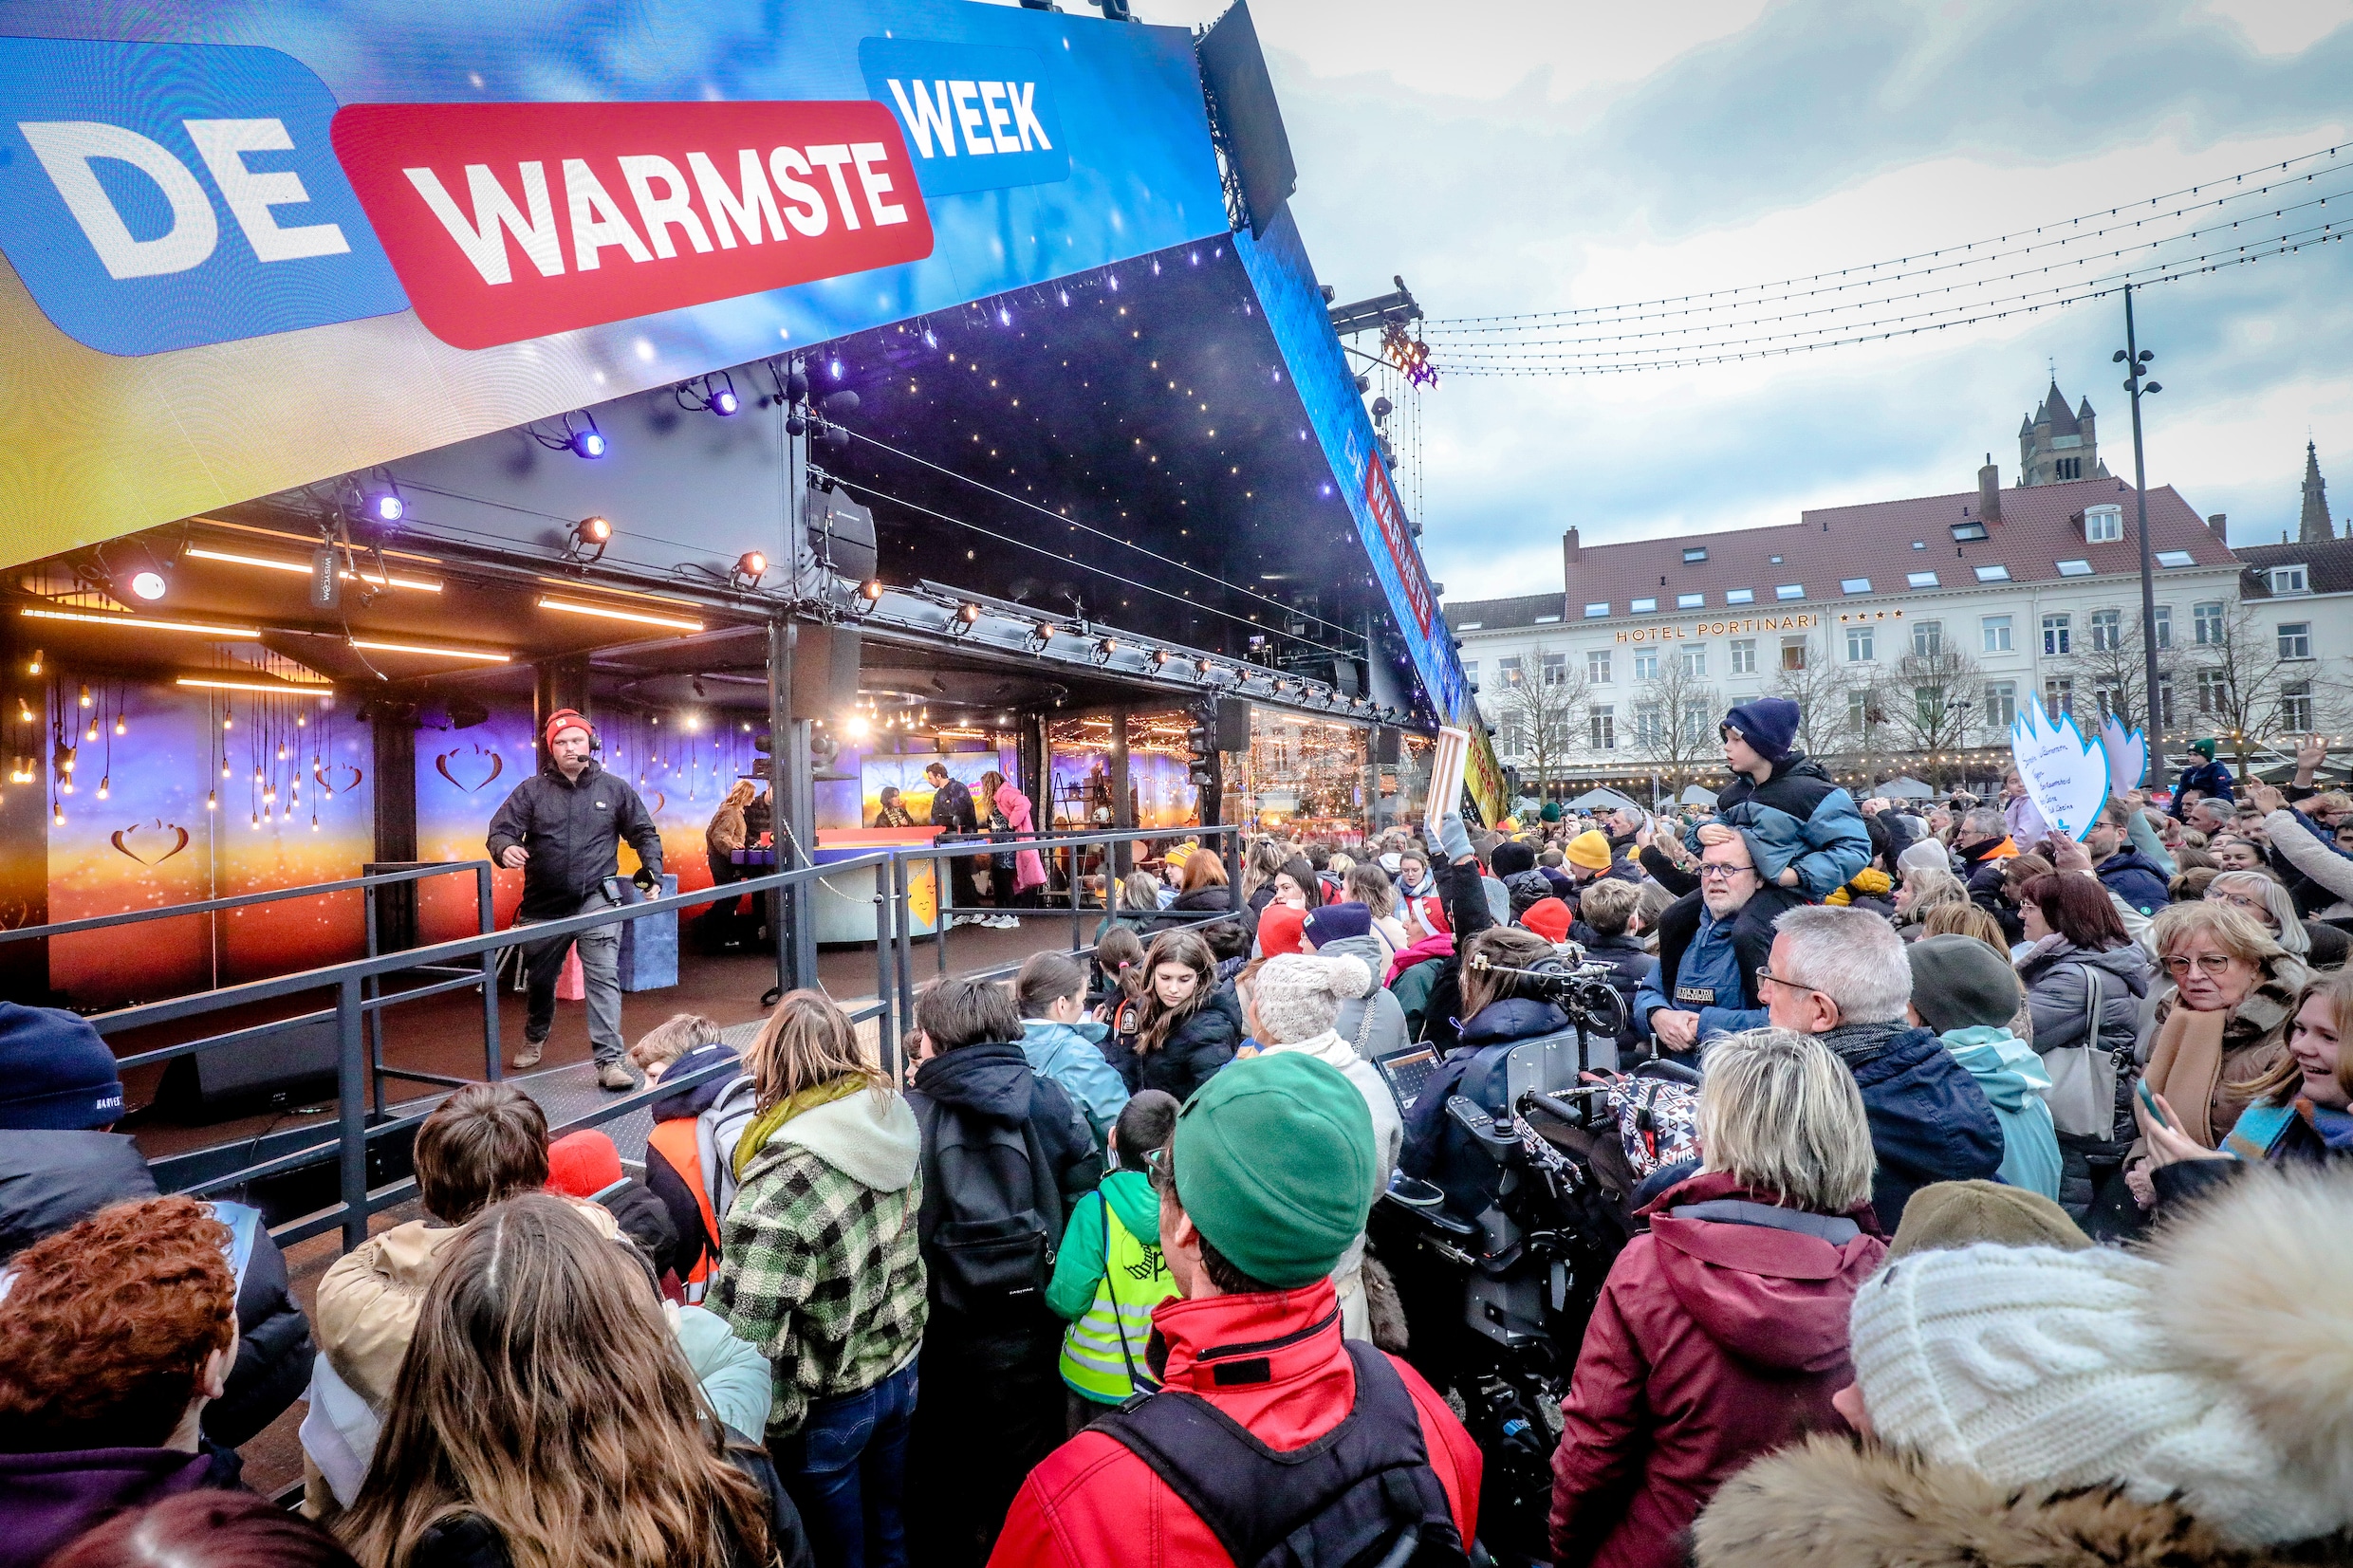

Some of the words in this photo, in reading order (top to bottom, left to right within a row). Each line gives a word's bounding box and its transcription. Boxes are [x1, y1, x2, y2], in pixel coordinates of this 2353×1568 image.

[886, 79, 1052, 160] WEEK
[17, 118, 351, 281] DE
[402, 142, 909, 286] WARMSTE
[323, 558, 332, 601] WISYCOM
[1372, 468, 1429, 626] WARMSTE
[1616, 625, 1685, 642] HOTEL
[1697, 614, 1818, 636] PORTINARI
[97, 1096, 121, 1109] HARVES
